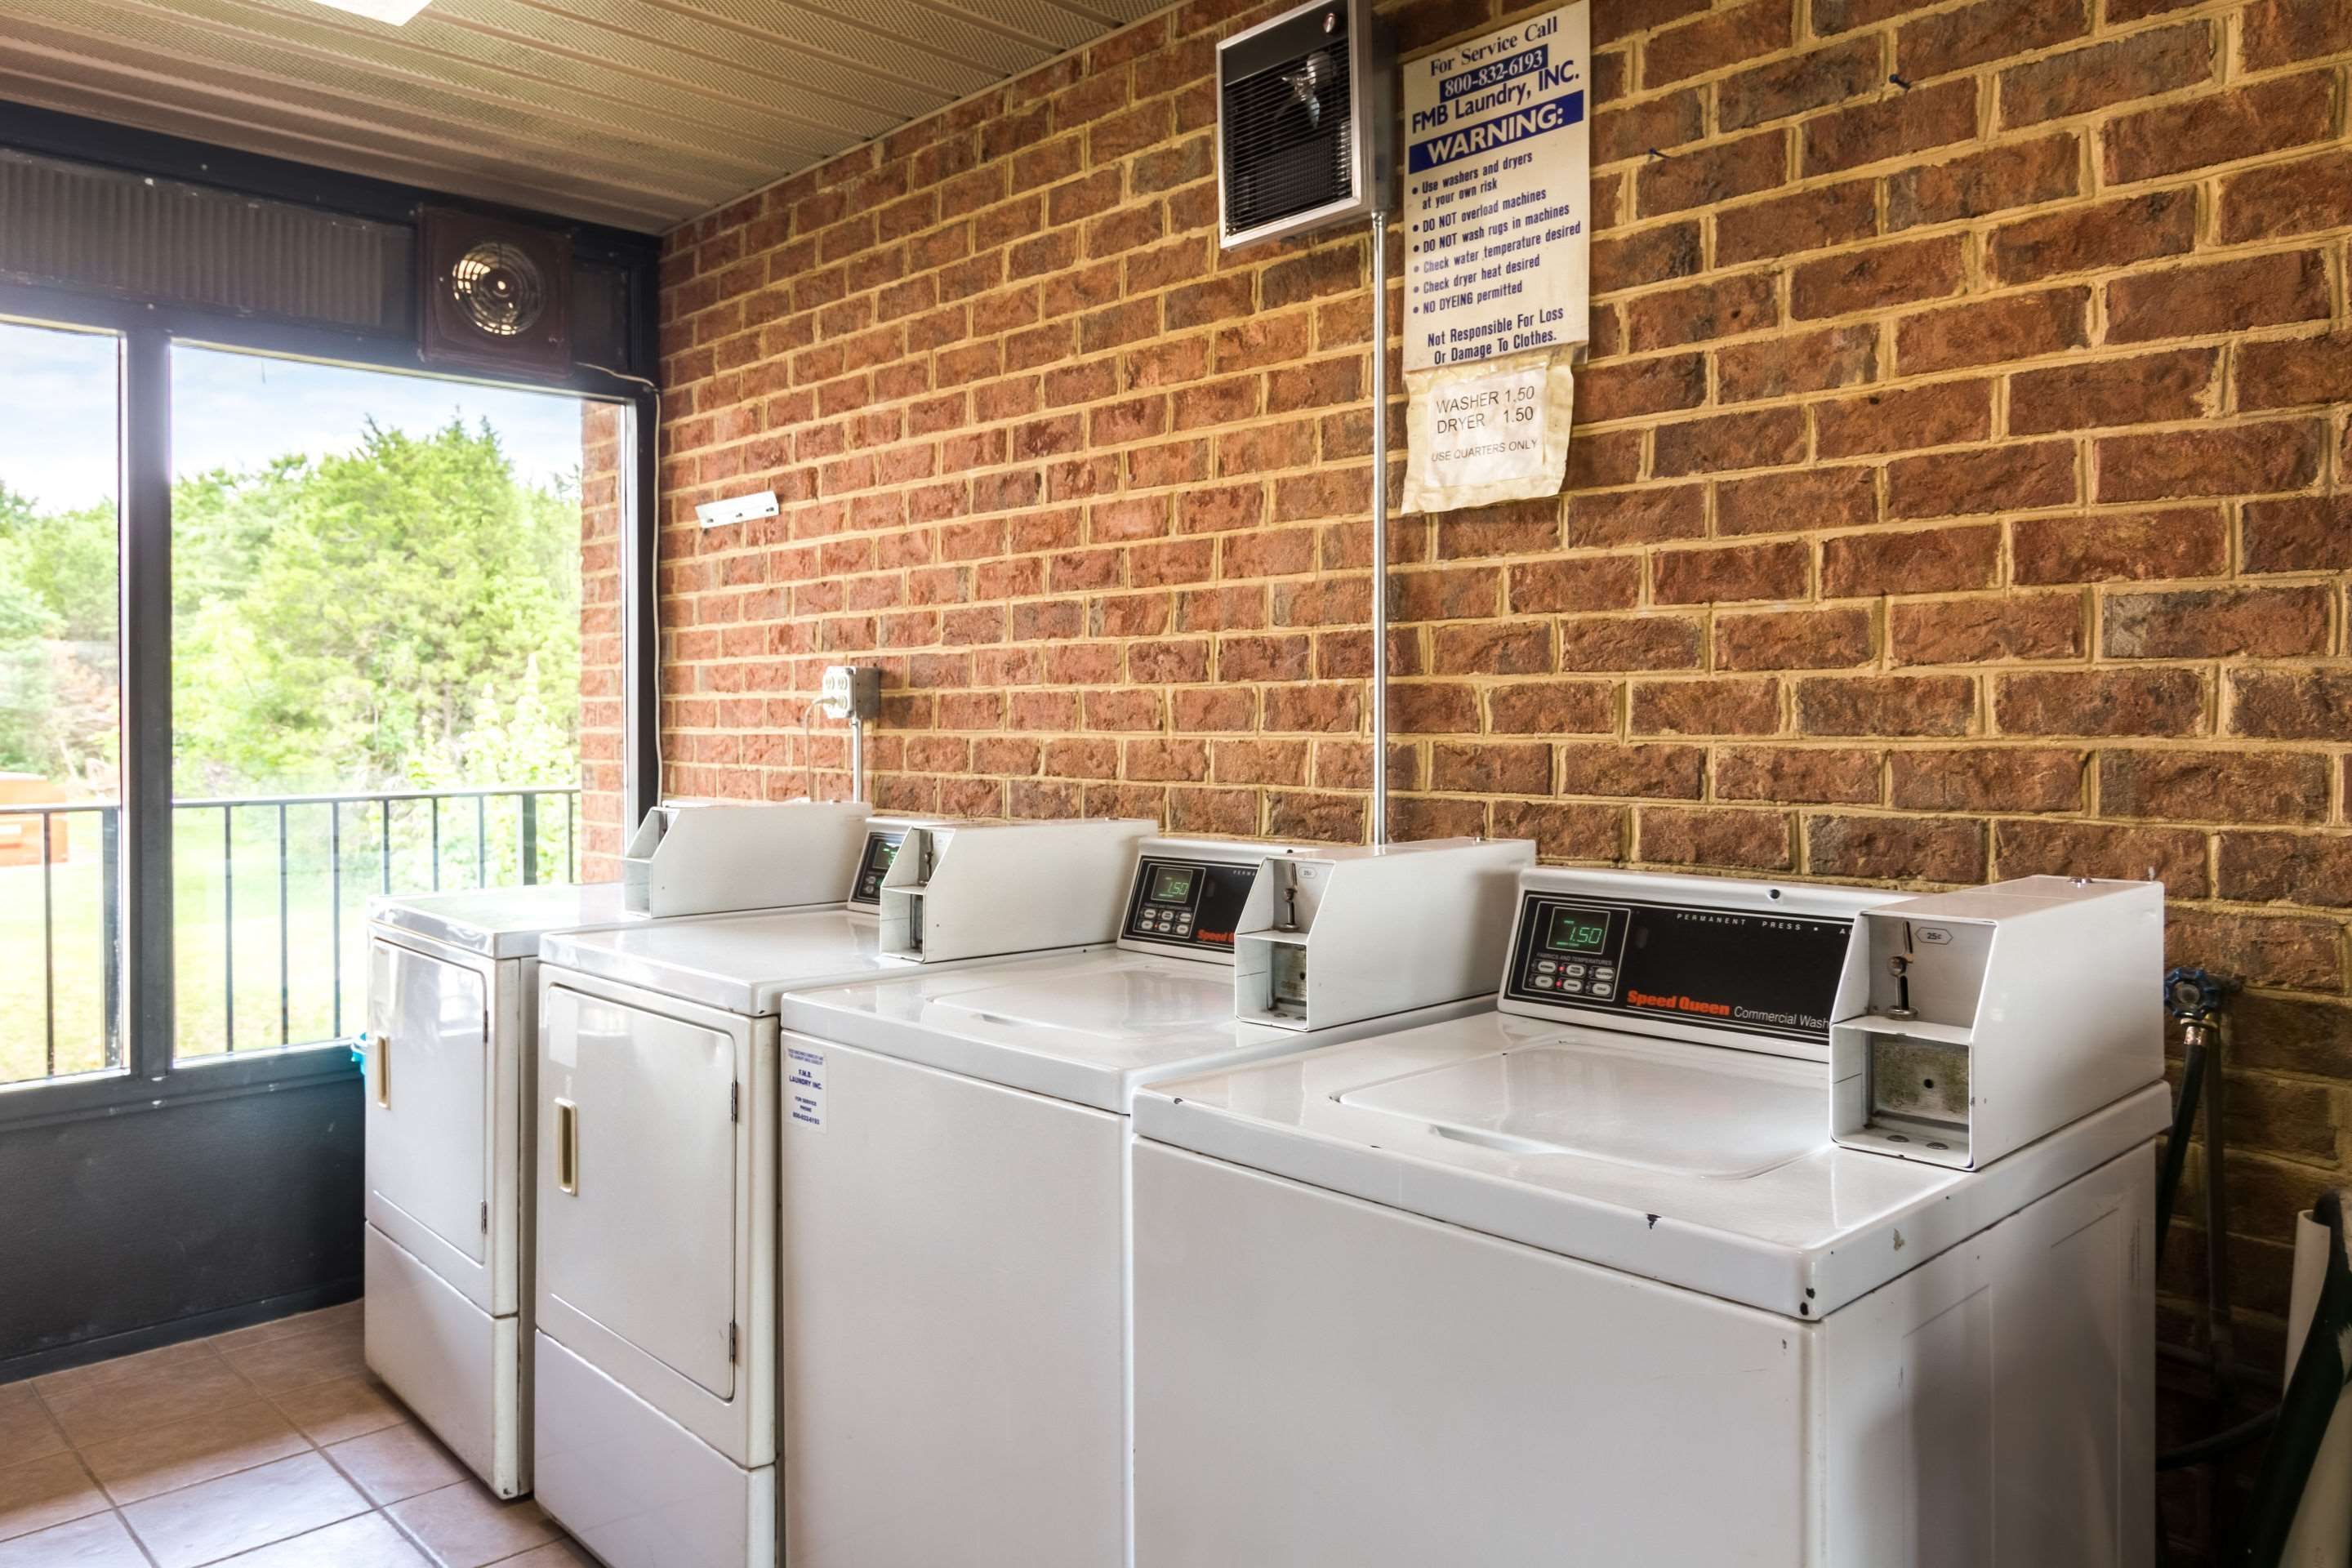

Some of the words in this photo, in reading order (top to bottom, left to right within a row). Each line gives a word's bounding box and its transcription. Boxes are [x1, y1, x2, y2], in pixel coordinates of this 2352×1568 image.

[1430, 56, 1454, 77] For
[1461, 35, 1517, 65] Service
[1525, 16, 1557, 41] Call
[1445, 50, 1543, 97] 800-832-6193
[1412, 105, 1448, 134] FMB
[1455, 82, 1531, 119] Laundry,
[1539, 60, 1579, 91] INC.
[1427, 104, 1564, 164] WARNING:
[1422, 180, 1438, 194] Use
[1442, 167, 1478, 188] washers
[1483, 161, 1499, 176] and
[1503, 152, 1532, 171] dryers
[1422, 197, 1431, 210] at
[1436, 192, 1454, 208] your
[1459, 187, 1477, 200] own
[1481, 178, 1498, 194] risk
[1423, 218, 1435, 233] DO
[1439, 212, 1457, 229] NOT
[1461, 202, 1499, 222] overload
[1503, 189, 1547, 210] machines
[1423, 239, 1435, 253] DO
[1439, 234, 1457, 250] NOT
[1462, 227, 1485, 243] wash
[1489, 221, 1508, 238] rugs
[1512, 215, 1521, 229] in
[1525, 204, 1570, 225] machines
[1423, 257, 1450, 274] Check
[1454, 250, 1479, 266] water
[1484, 234, 1541, 259] temperature
[1545, 221, 1581, 242] desired
[1423, 277, 1450, 294] Check
[1454, 271, 1477, 287] dryer
[1481, 265, 1501, 279] heat
[1506, 254, 1540, 274] desired
[1423, 301, 1435, 314] NO
[1439, 292, 1473, 311] DYEING
[1477, 280, 1522, 303] permitted
[1428, 332, 1445, 348] Not
[1450, 318, 1512, 343] Responsible
[1517, 313, 1535, 329] For
[1539, 307, 1564, 323] Loss
[1434, 350, 1446, 364] Or
[1451, 342, 1492, 362] Damage
[1499, 337, 1508, 353] To
[1513, 330, 1557, 349] Clothes.
[1437, 391, 1499, 414] WASHER
[1504, 385, 1535, 403] 1.50
[1437, 412, 1485, 434] DRYER
[1503, 406, 1534, 424] 1.50
[1432, 451, 1451, 462] USE
[1454, 443, 1505, 459] QUARTERS
[1508, 439, 1538, 452] ONLY
[1677, 913, 1746, 925] PERMANENT
[1762, 920, 1802, 931] PRESS
[1627, 990, 1677, 1009] Speed
[1678, 996, 1731, 1016] Queen
[1734, 1006, 1797, 1025] Commercial
[789, 1076, 811, 1087] LAUNDRY
